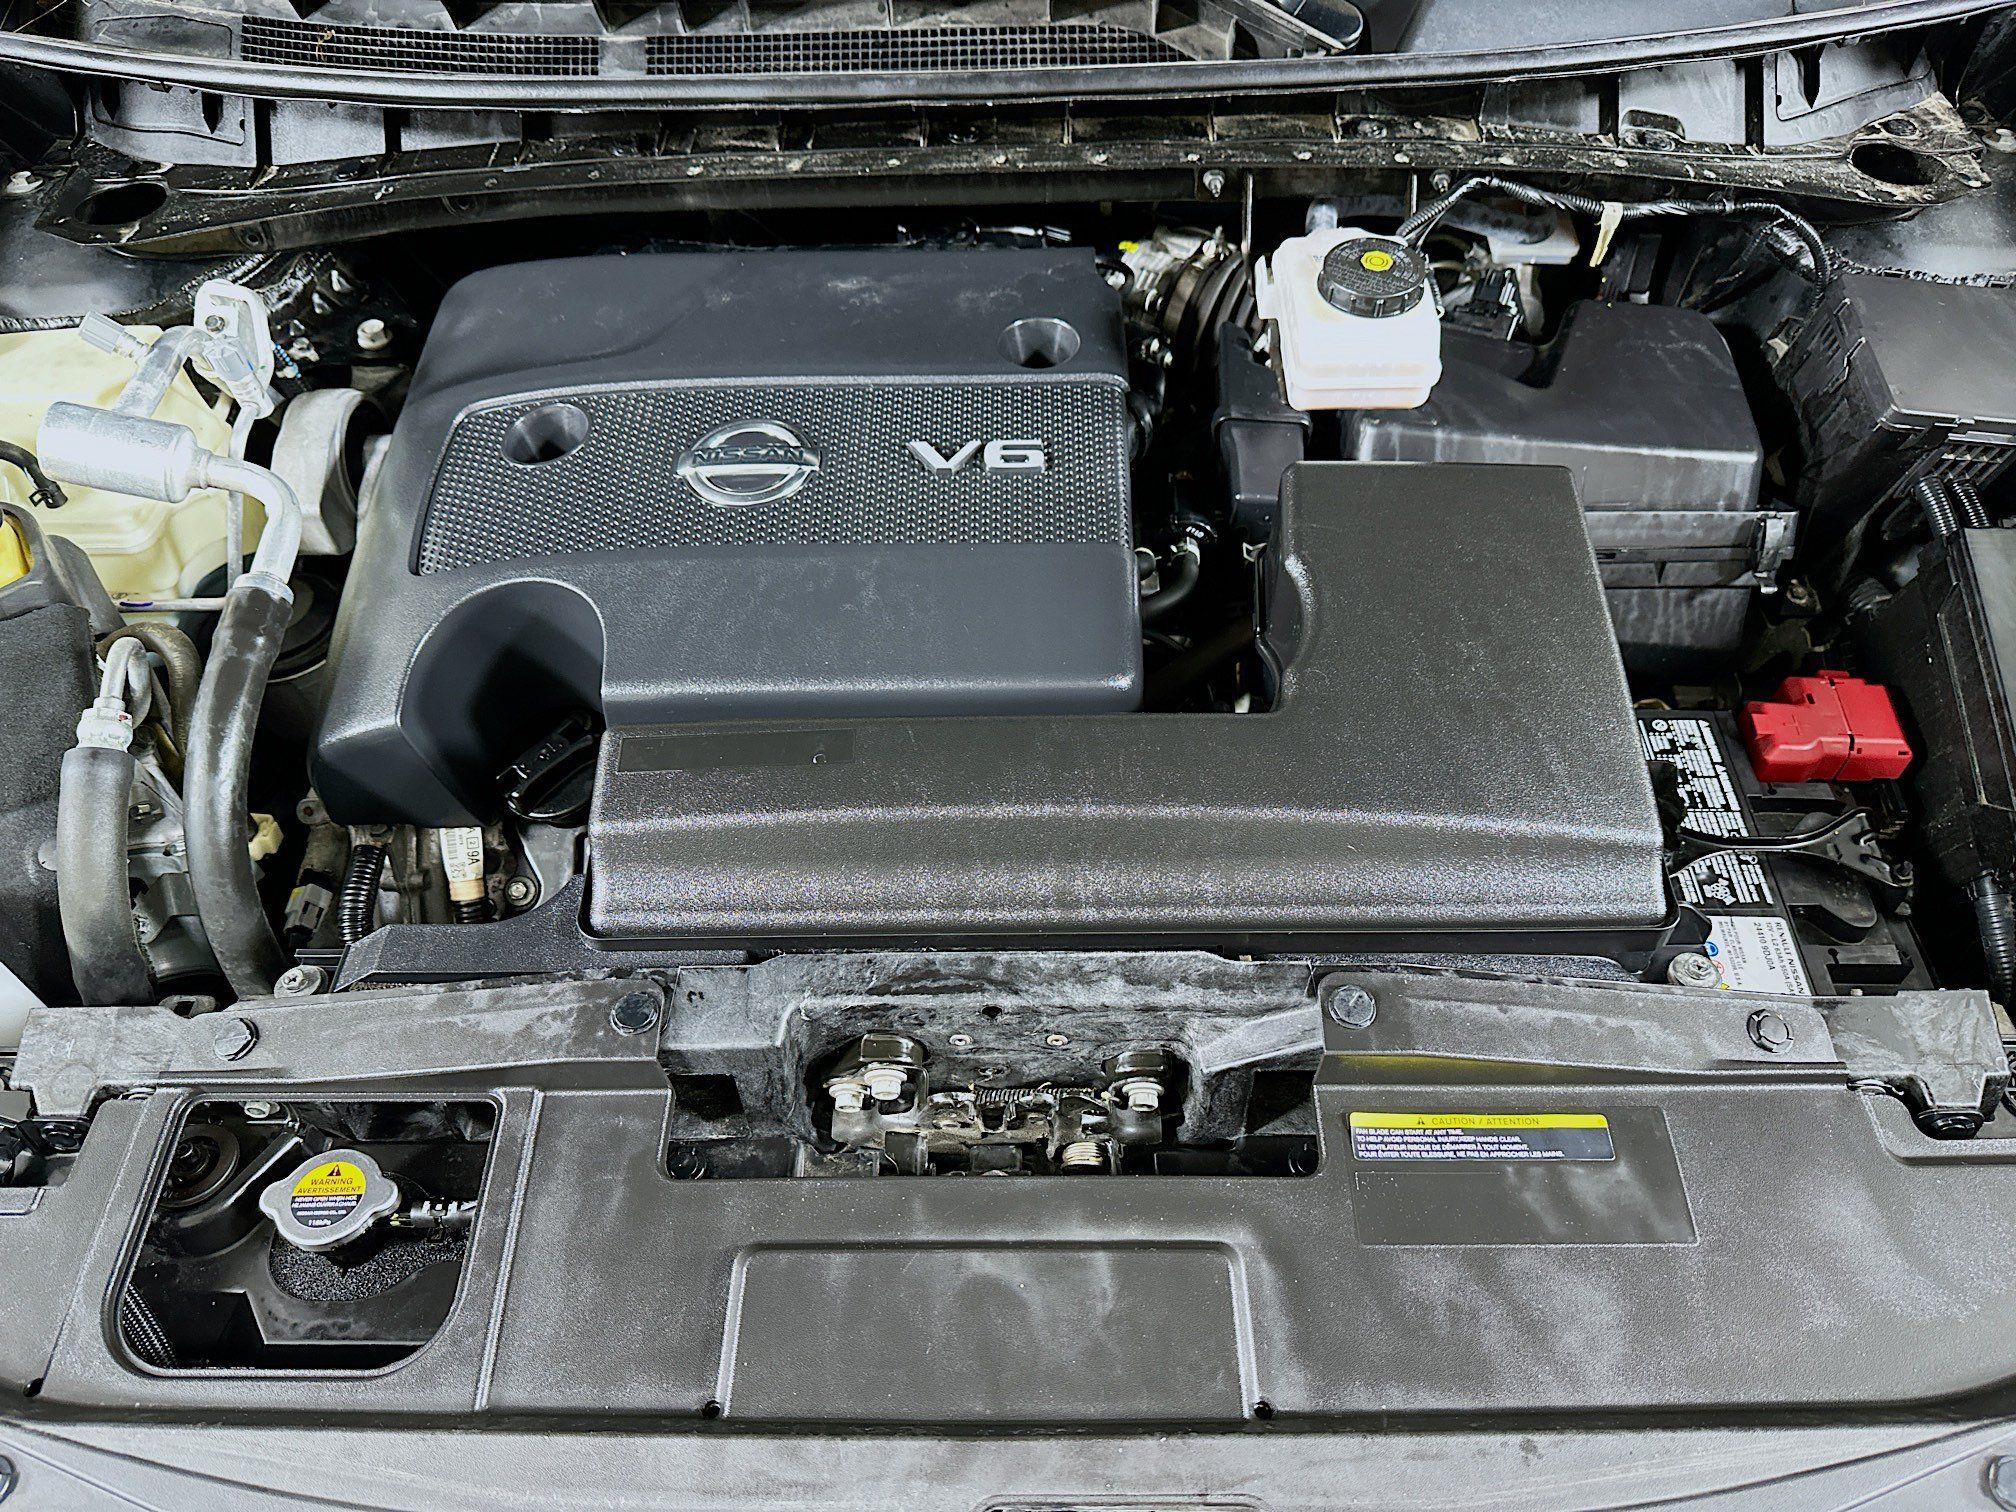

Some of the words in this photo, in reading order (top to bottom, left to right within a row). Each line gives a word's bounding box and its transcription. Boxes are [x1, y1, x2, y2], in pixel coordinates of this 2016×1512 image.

[691, 446, 806, 465] NISSAN
[907, 438, 1047, 476] V6
[467, 851, 480, 866] 9A
[1753, 922, 1767, 944] 24410
[1775, 922, 1791, 955] RENAULT
[1788, 958, 1804, 994] NISSAN
[1431, 1117, 1475, 1125] CAUTION
[297, 1186, 362, 1194] AVERTISSEMENT
[311, 1178, 354, 1186] WARNING
